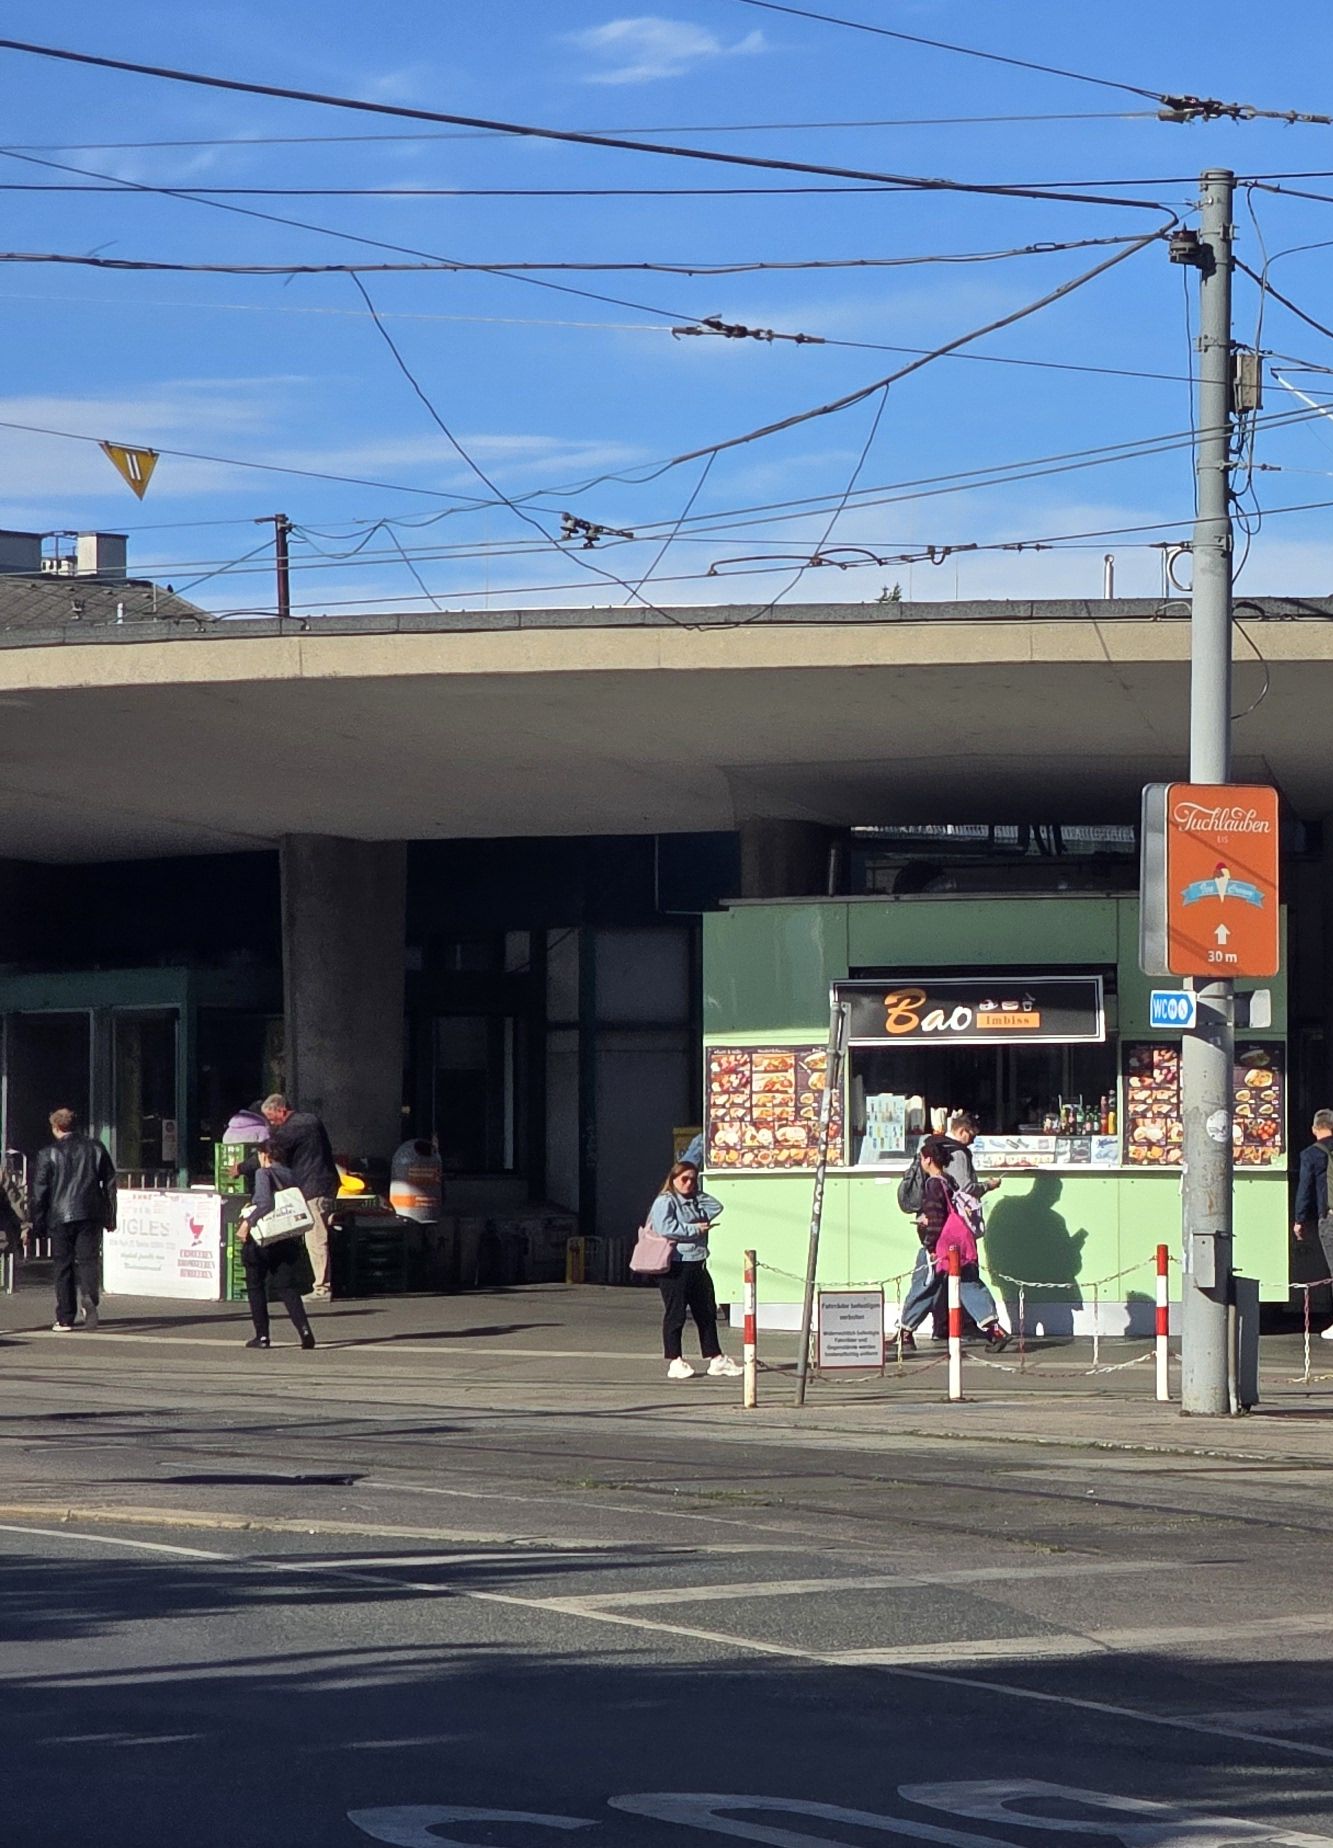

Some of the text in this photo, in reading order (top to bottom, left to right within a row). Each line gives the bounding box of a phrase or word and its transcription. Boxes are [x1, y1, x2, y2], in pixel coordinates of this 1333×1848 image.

[1173, 801, 1271, 833] Tuchlauben
[1207, 950, 1238, 964] 30 m
[883, 987, 973, 1034] Bao
[1153, 998, 1168, 1019] WC
[986, 1013, 1031, 1026] Imbiss
[114, 1218, 171, 1237] IGLES
